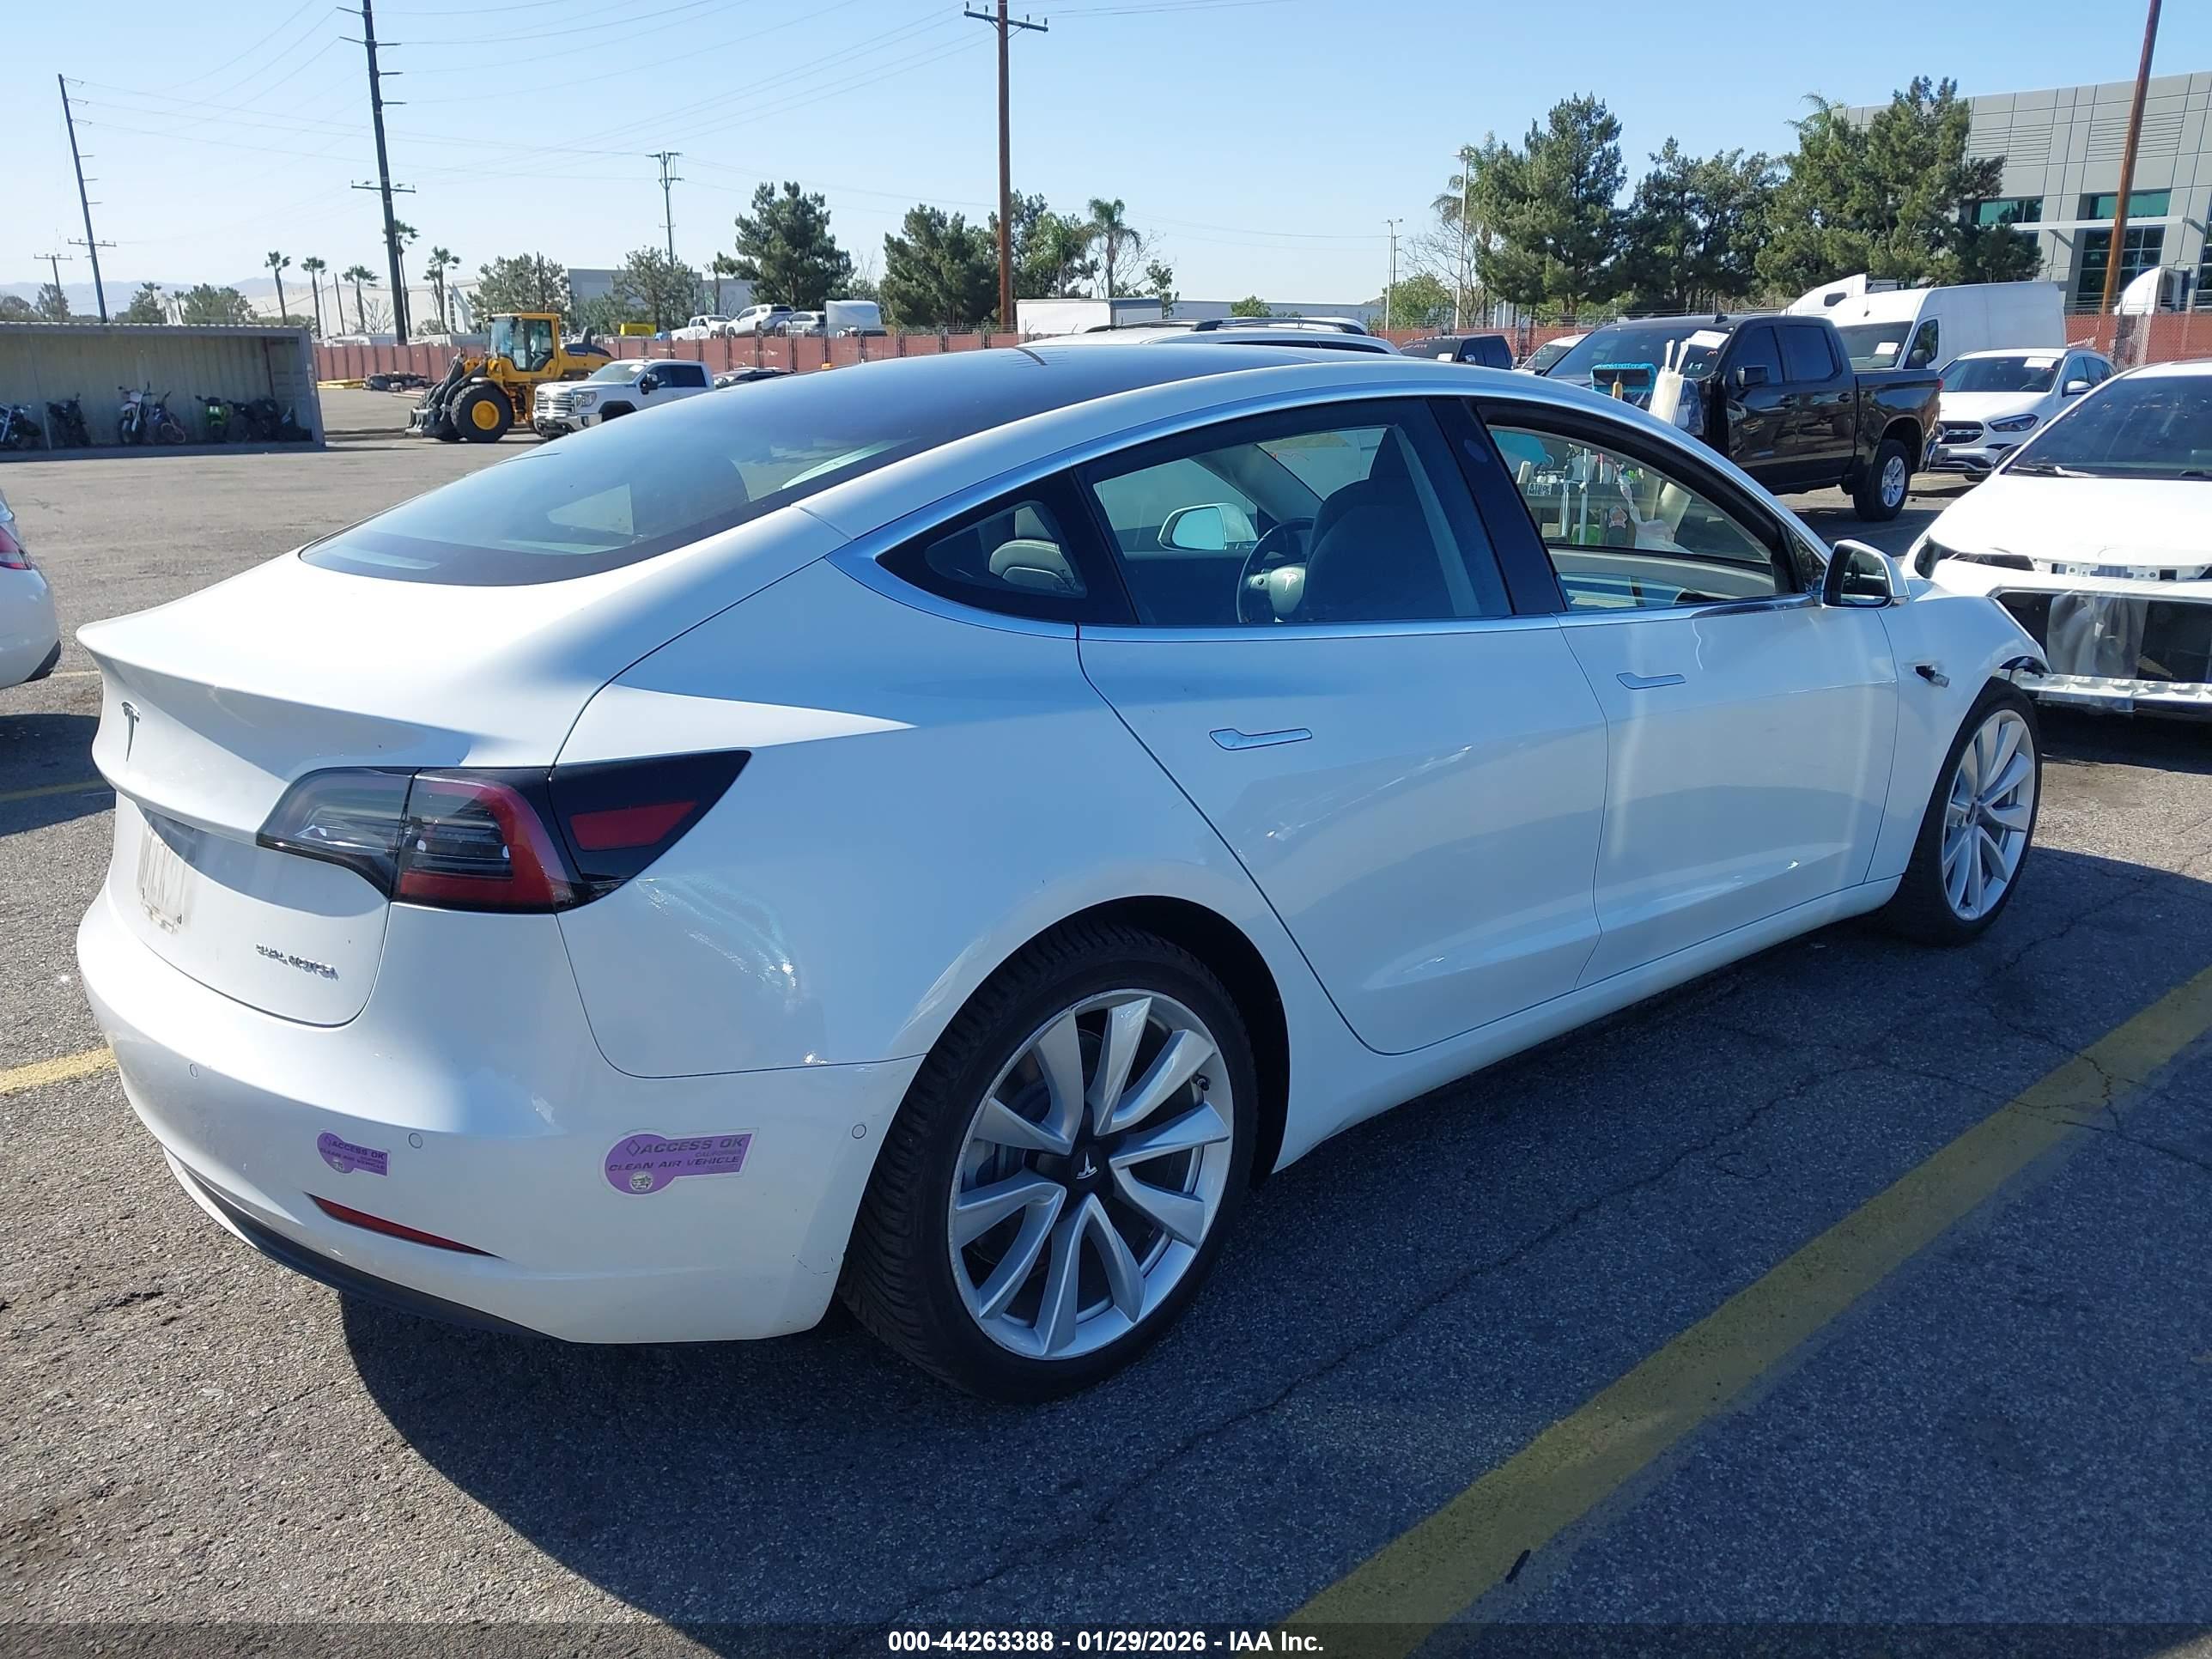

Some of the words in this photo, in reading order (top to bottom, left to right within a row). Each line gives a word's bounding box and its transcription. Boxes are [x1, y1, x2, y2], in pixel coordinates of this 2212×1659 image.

[328, 1139, 368, 1156] ACCESS
[370, 1151, 385, 1160] OK
[640, 1139, 713, 1155] ACCESS
[720, 1137, 746, 1148] OK
[608, 1162, 653, 1171] CLEAN
[658, 1160, 682, 1169] AIR
[687, 1155, 740, 1166] VEHICLE
